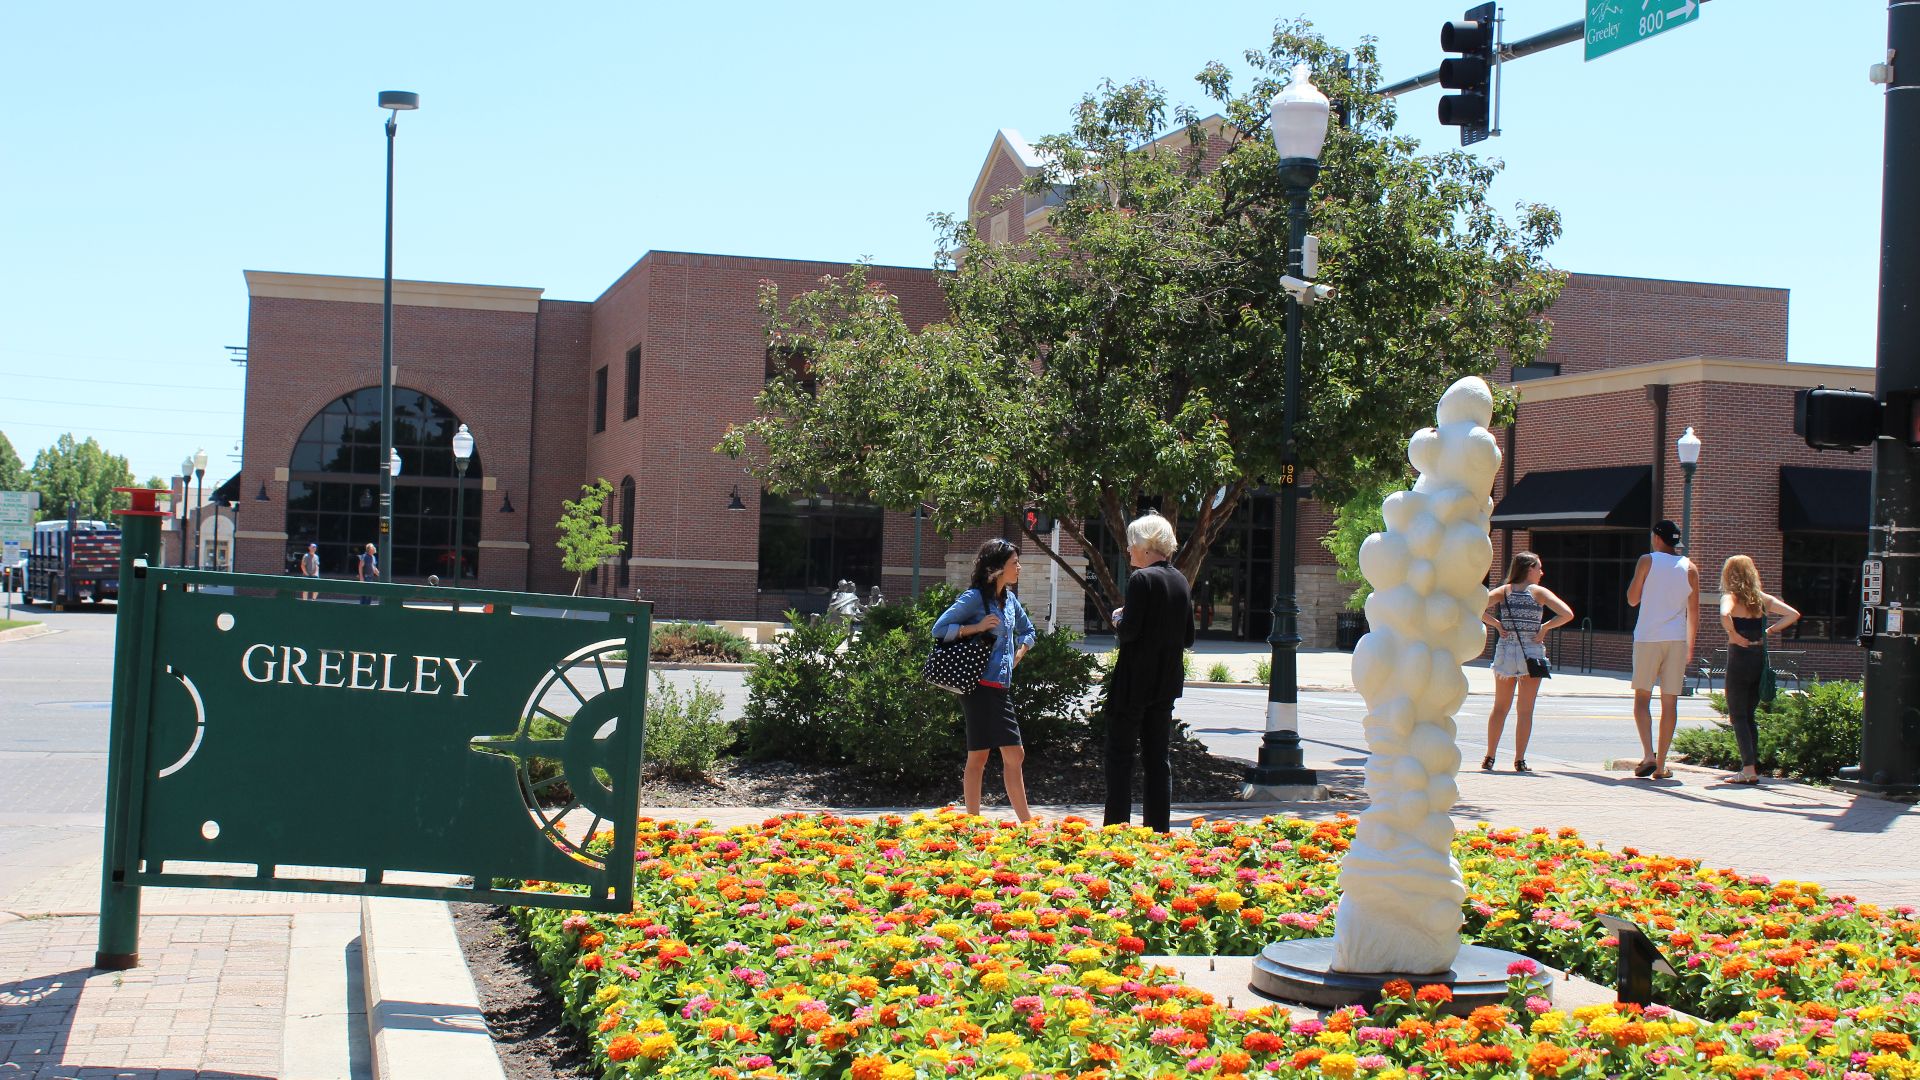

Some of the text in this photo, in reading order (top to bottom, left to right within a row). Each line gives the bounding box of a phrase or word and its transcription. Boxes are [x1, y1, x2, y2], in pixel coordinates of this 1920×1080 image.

[1587, 22, 1620, 44] Greeley
[1639, 10, 1664, 36] 800
[1282, 464, 1294, 474] 19
[241, 643, 483, 698] GREELEY
